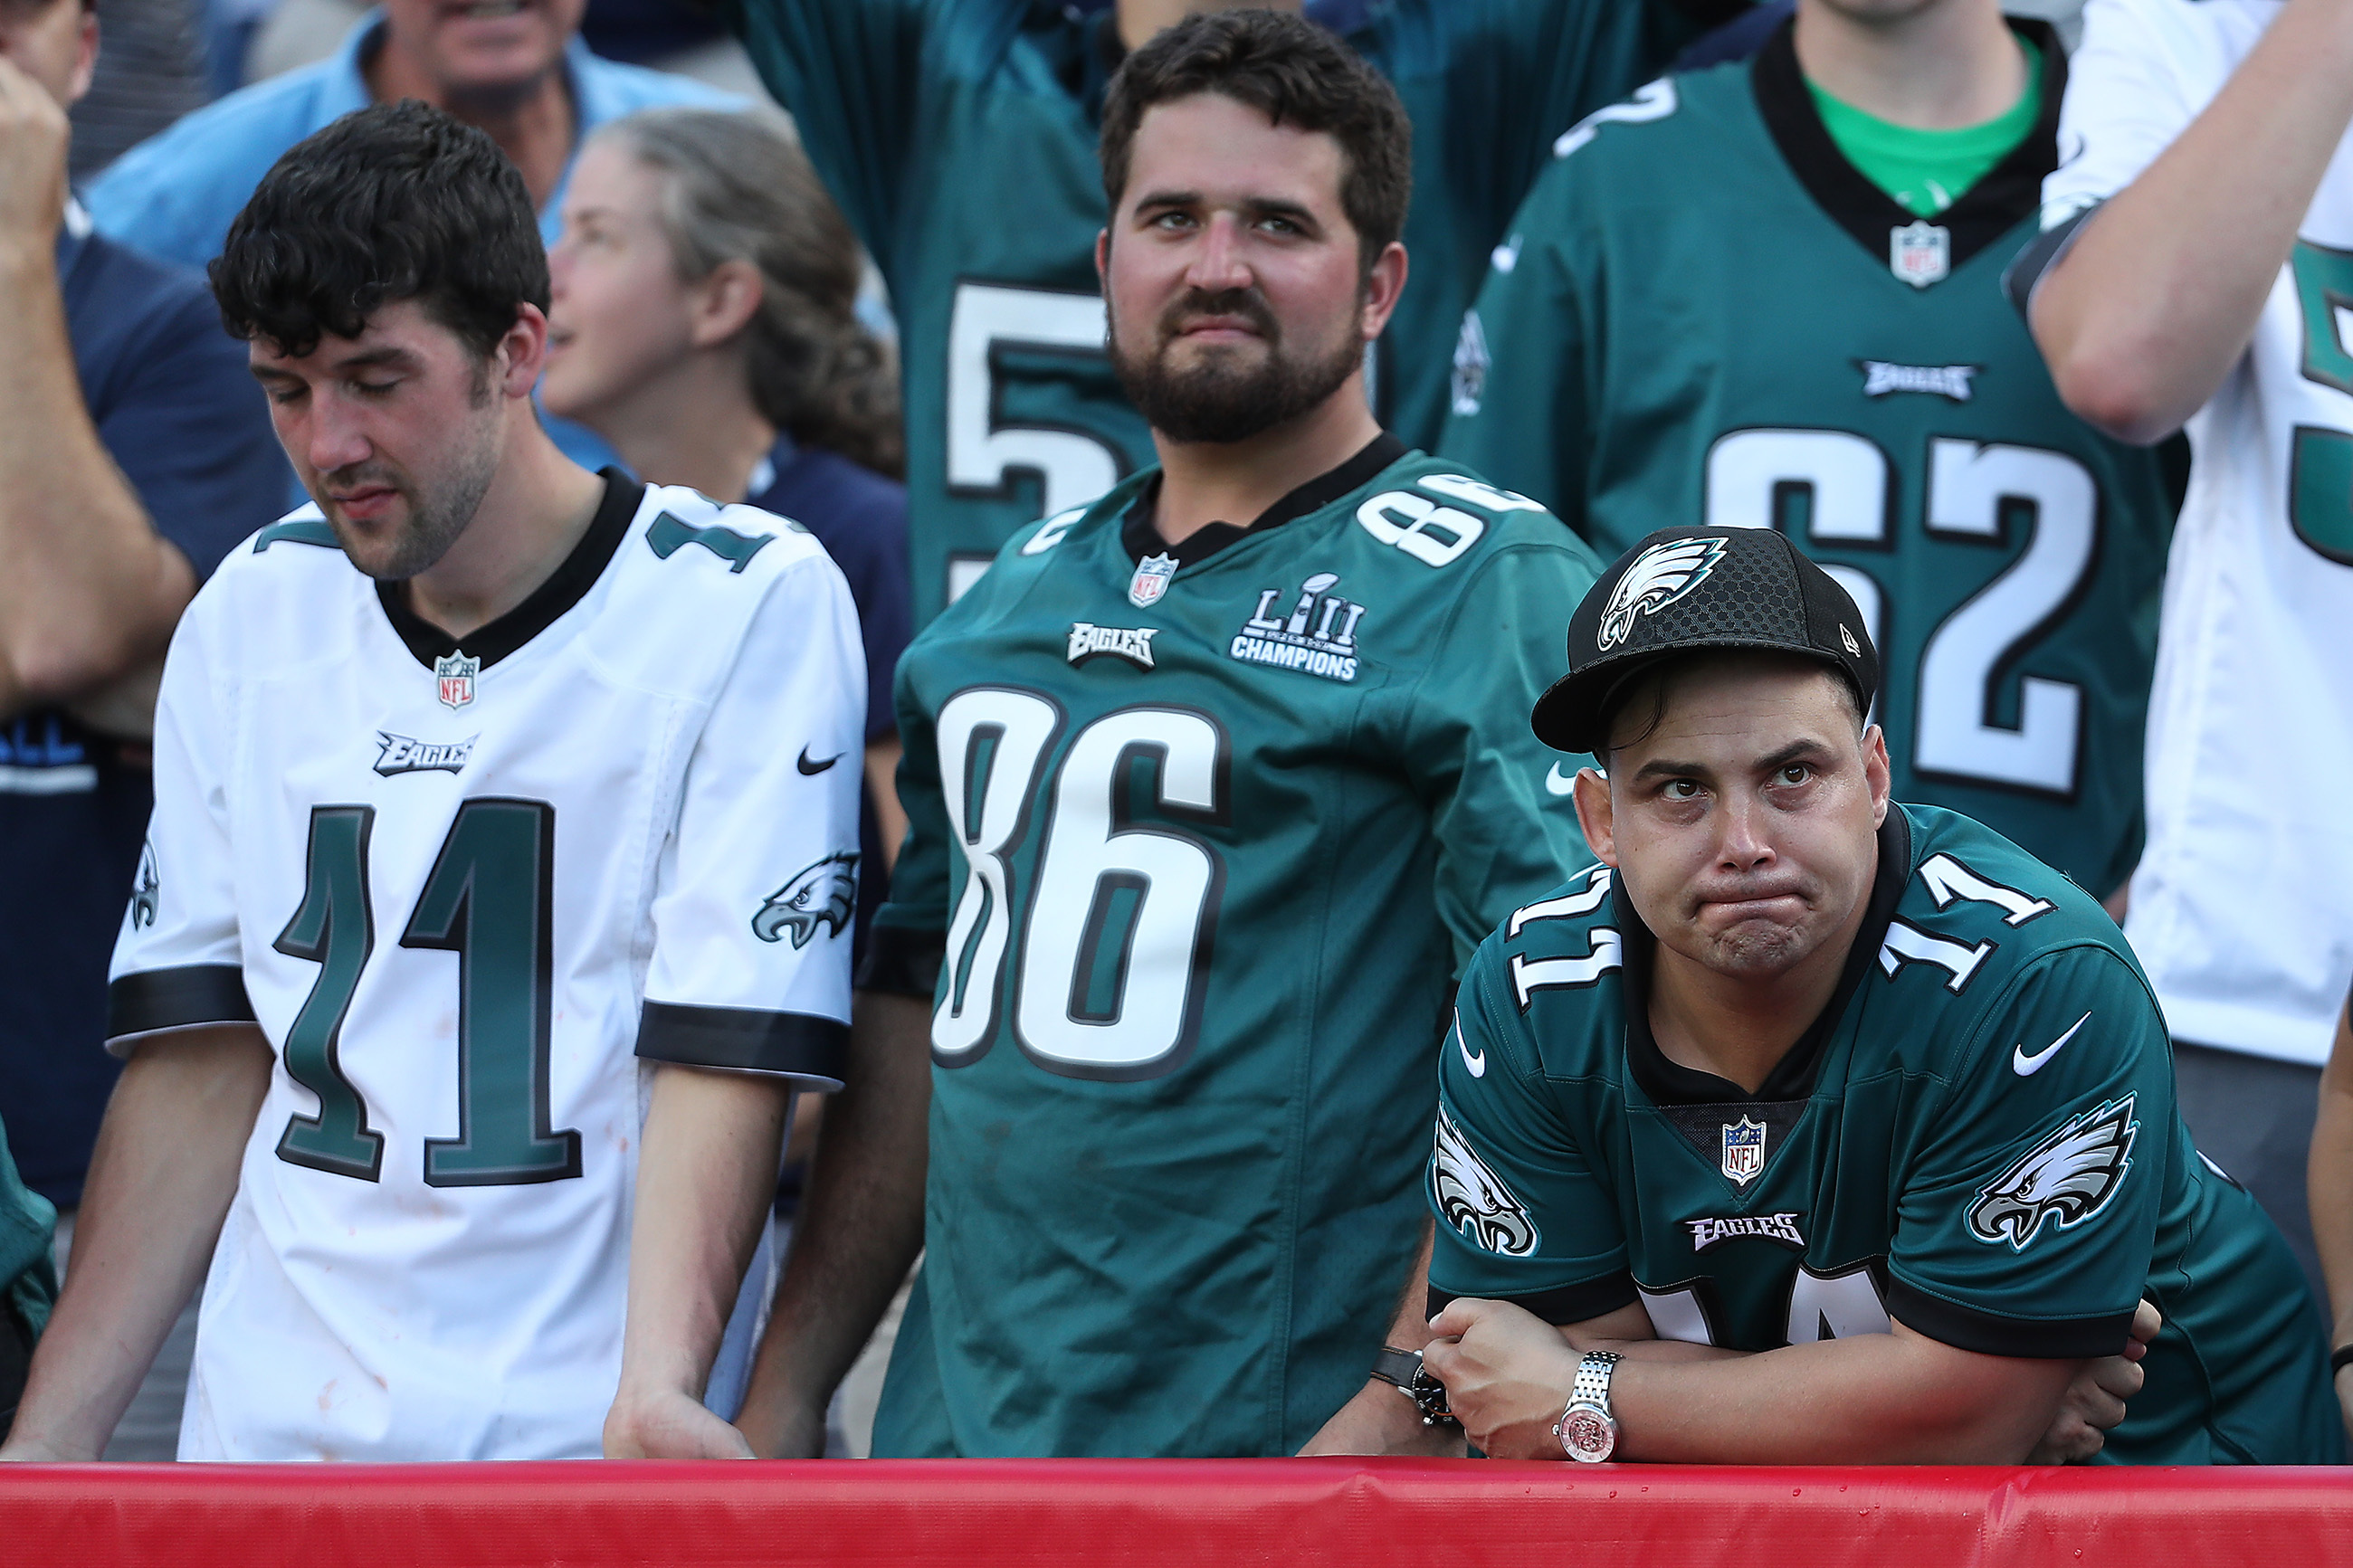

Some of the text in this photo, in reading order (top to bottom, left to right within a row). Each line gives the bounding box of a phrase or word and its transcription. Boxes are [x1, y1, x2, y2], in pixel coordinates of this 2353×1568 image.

[1705, 425, 2100, 798] 62
[1066, 622, 1161, 669] EAGLES
[1230, 634, 1360, 681] CHAMPIONS
[440, 678, 472, 704] NFL
[930, 685, 1233, 1082] 86
[272, 795, 584, 1188] 11
[1729, 1146, 1760, 1173] NFL
[1684, 1212, 1806, 1252] EAGLES
